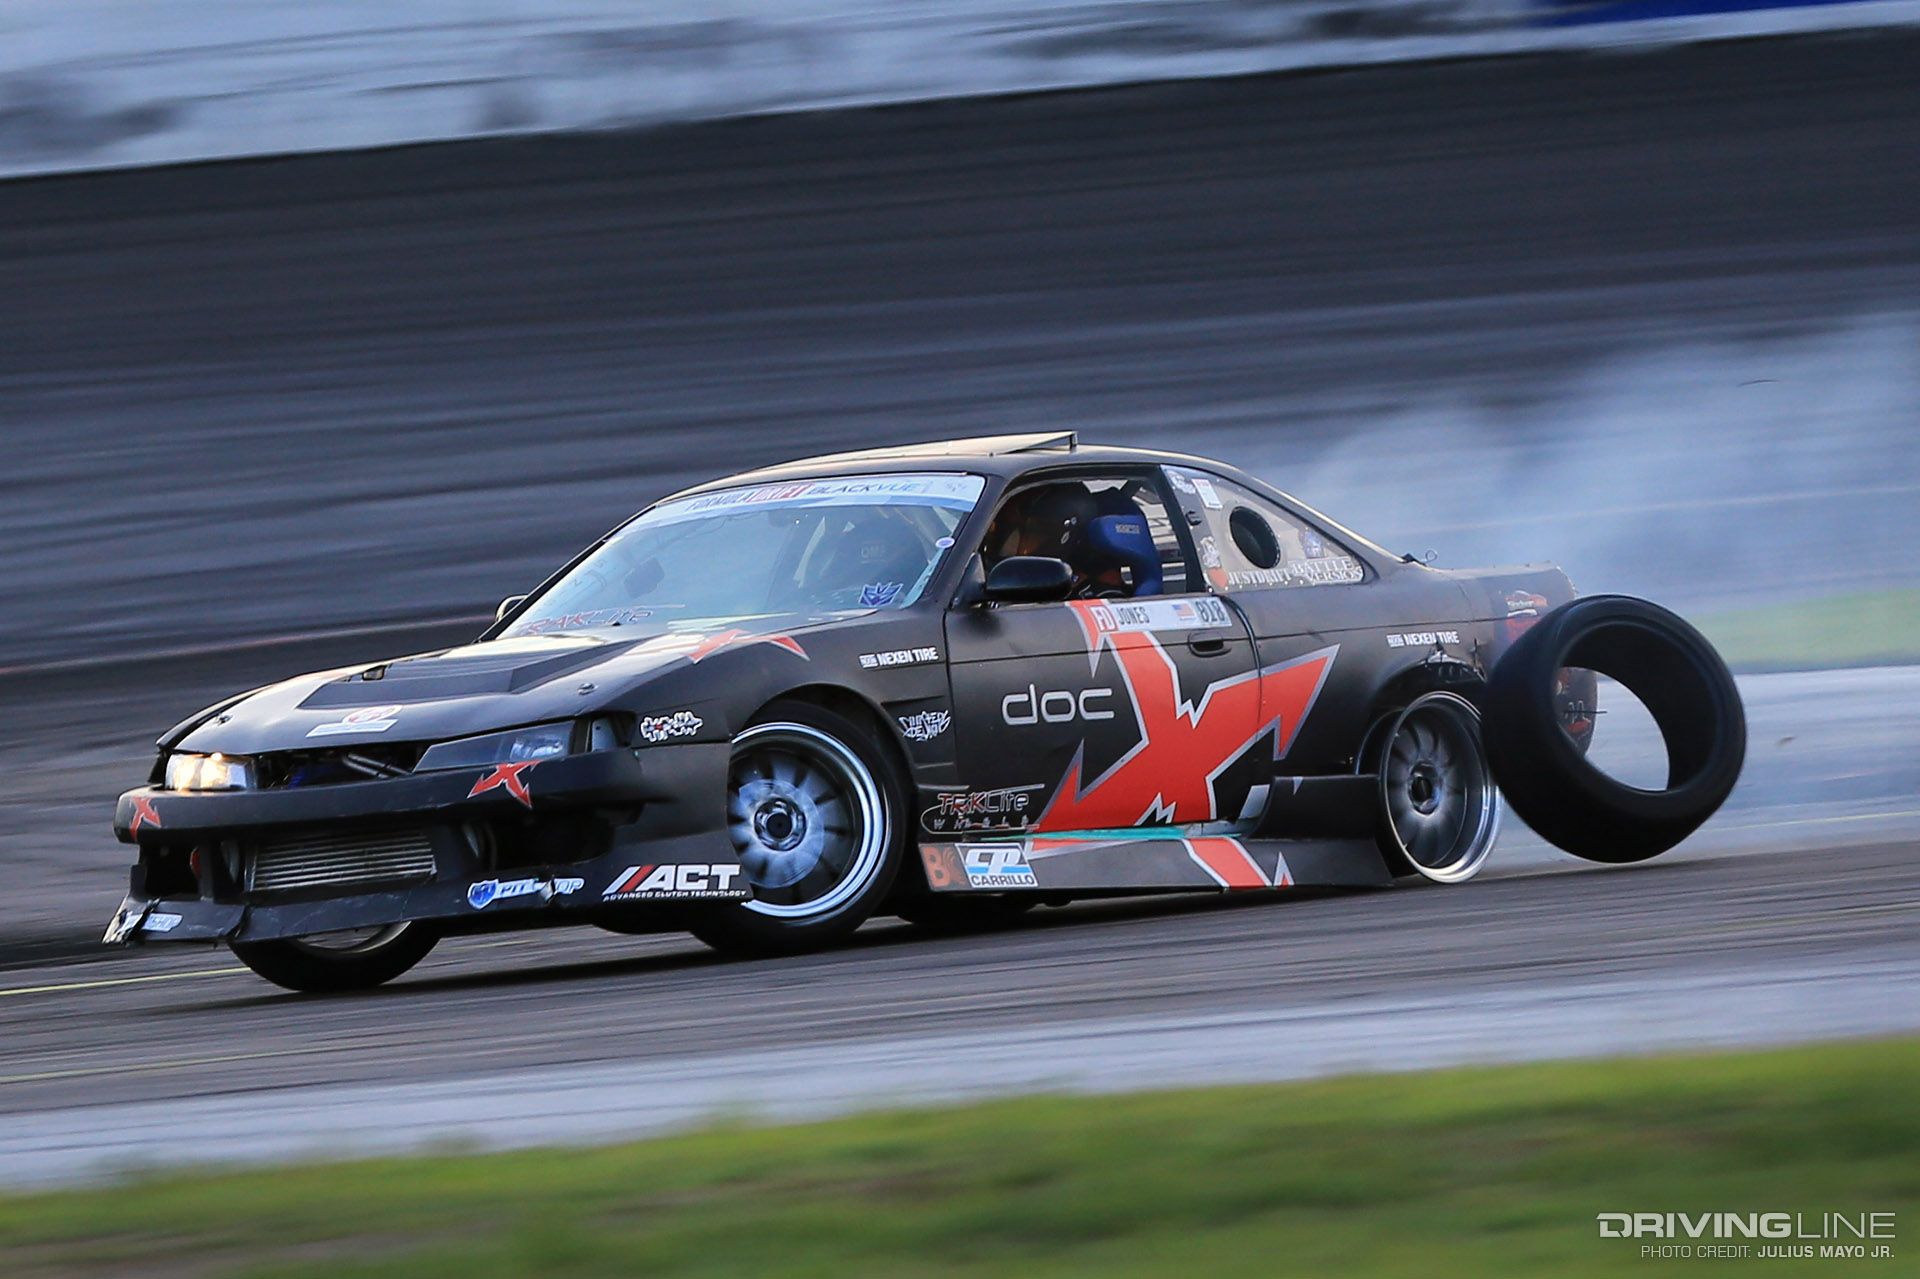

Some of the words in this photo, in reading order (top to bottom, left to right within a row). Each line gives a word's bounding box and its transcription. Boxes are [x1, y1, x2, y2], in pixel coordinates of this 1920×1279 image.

[807, 482, 918, 496] BLACKVUE
[1116, 606, 1151, 626] JONES
[1195, 600, 1226, 623] 818
[1403, 631, 1437, 646] NEXEN
[1436, 630, 1460, 644] TIRE
[877, 650, 913, 666] NEXEN
[912, 646, 939, 661] TIRE
[1001, 683, 1115, 726] doc
[634, 864, 741, 892] ACT
[970, 874, 1036, 886] CARRILLO
[603, 891, 653, 903] ADVANCED
[654, 890, 690, 898] CLUTCH
